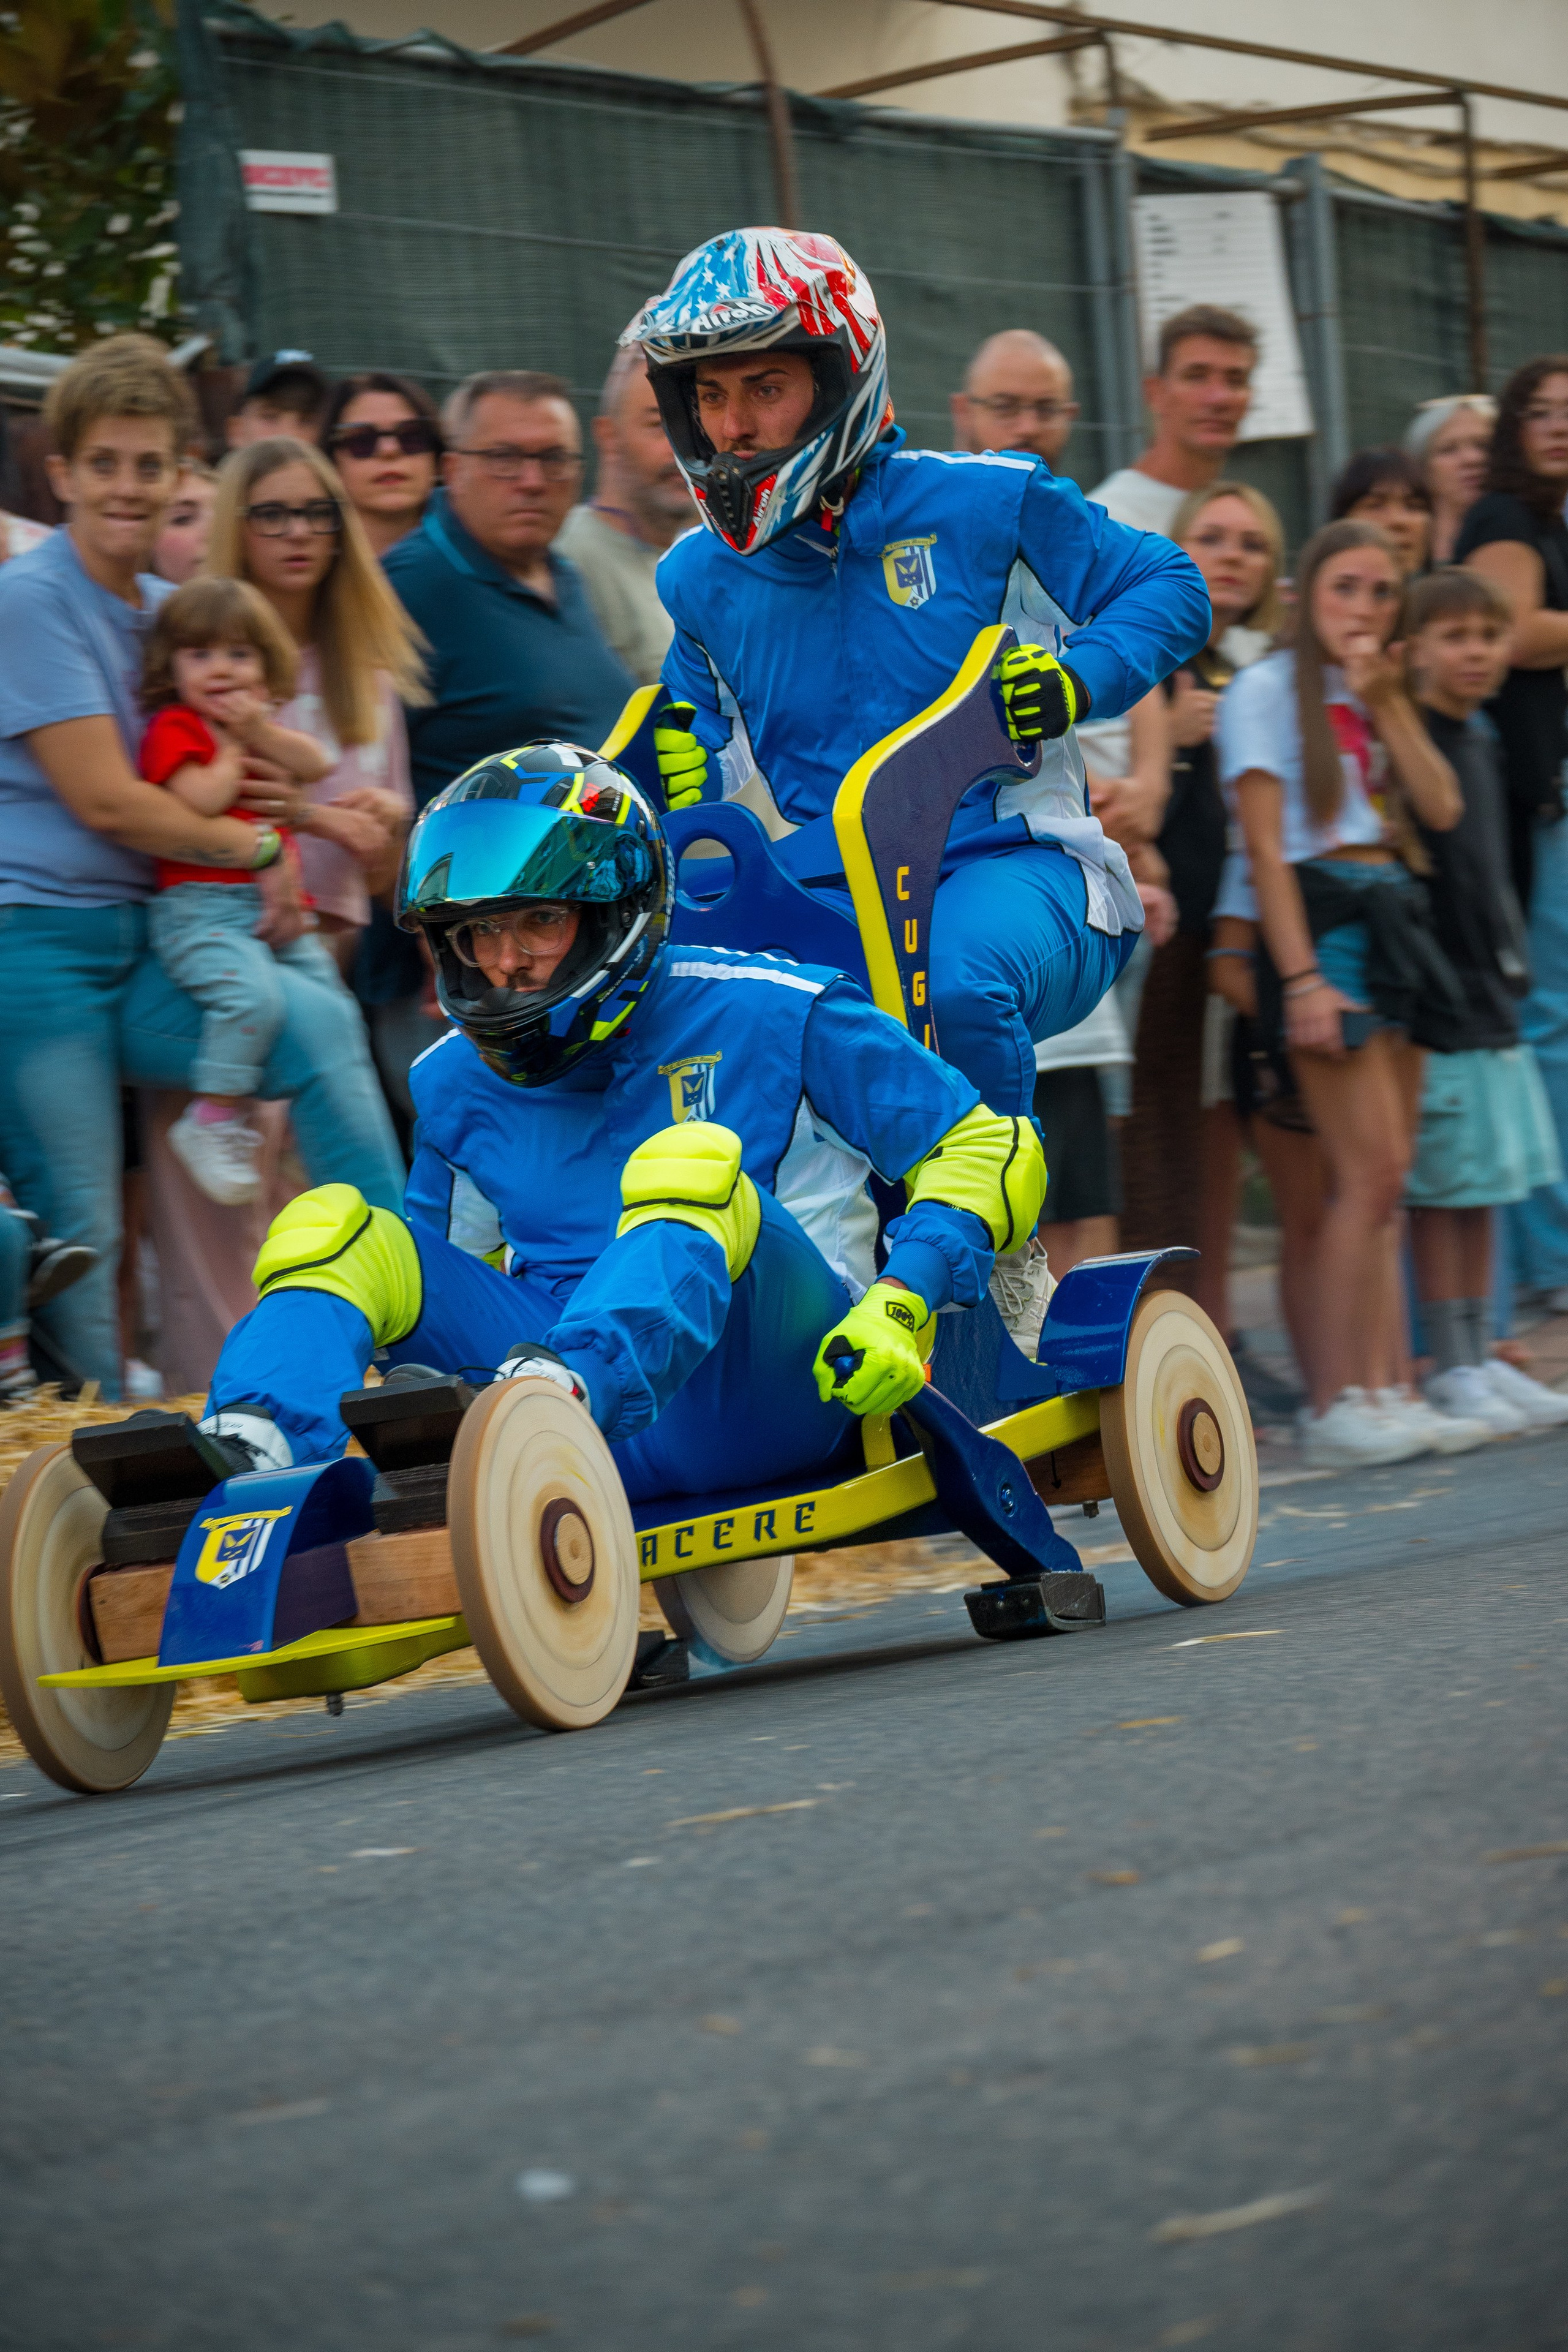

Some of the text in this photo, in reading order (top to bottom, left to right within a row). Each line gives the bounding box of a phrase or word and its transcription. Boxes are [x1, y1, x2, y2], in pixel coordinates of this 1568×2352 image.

[691, 301, 772, 333] Airoh
[753, 488, 771, 529] Airoh
[891, 1306, 913, 1327] 100%
